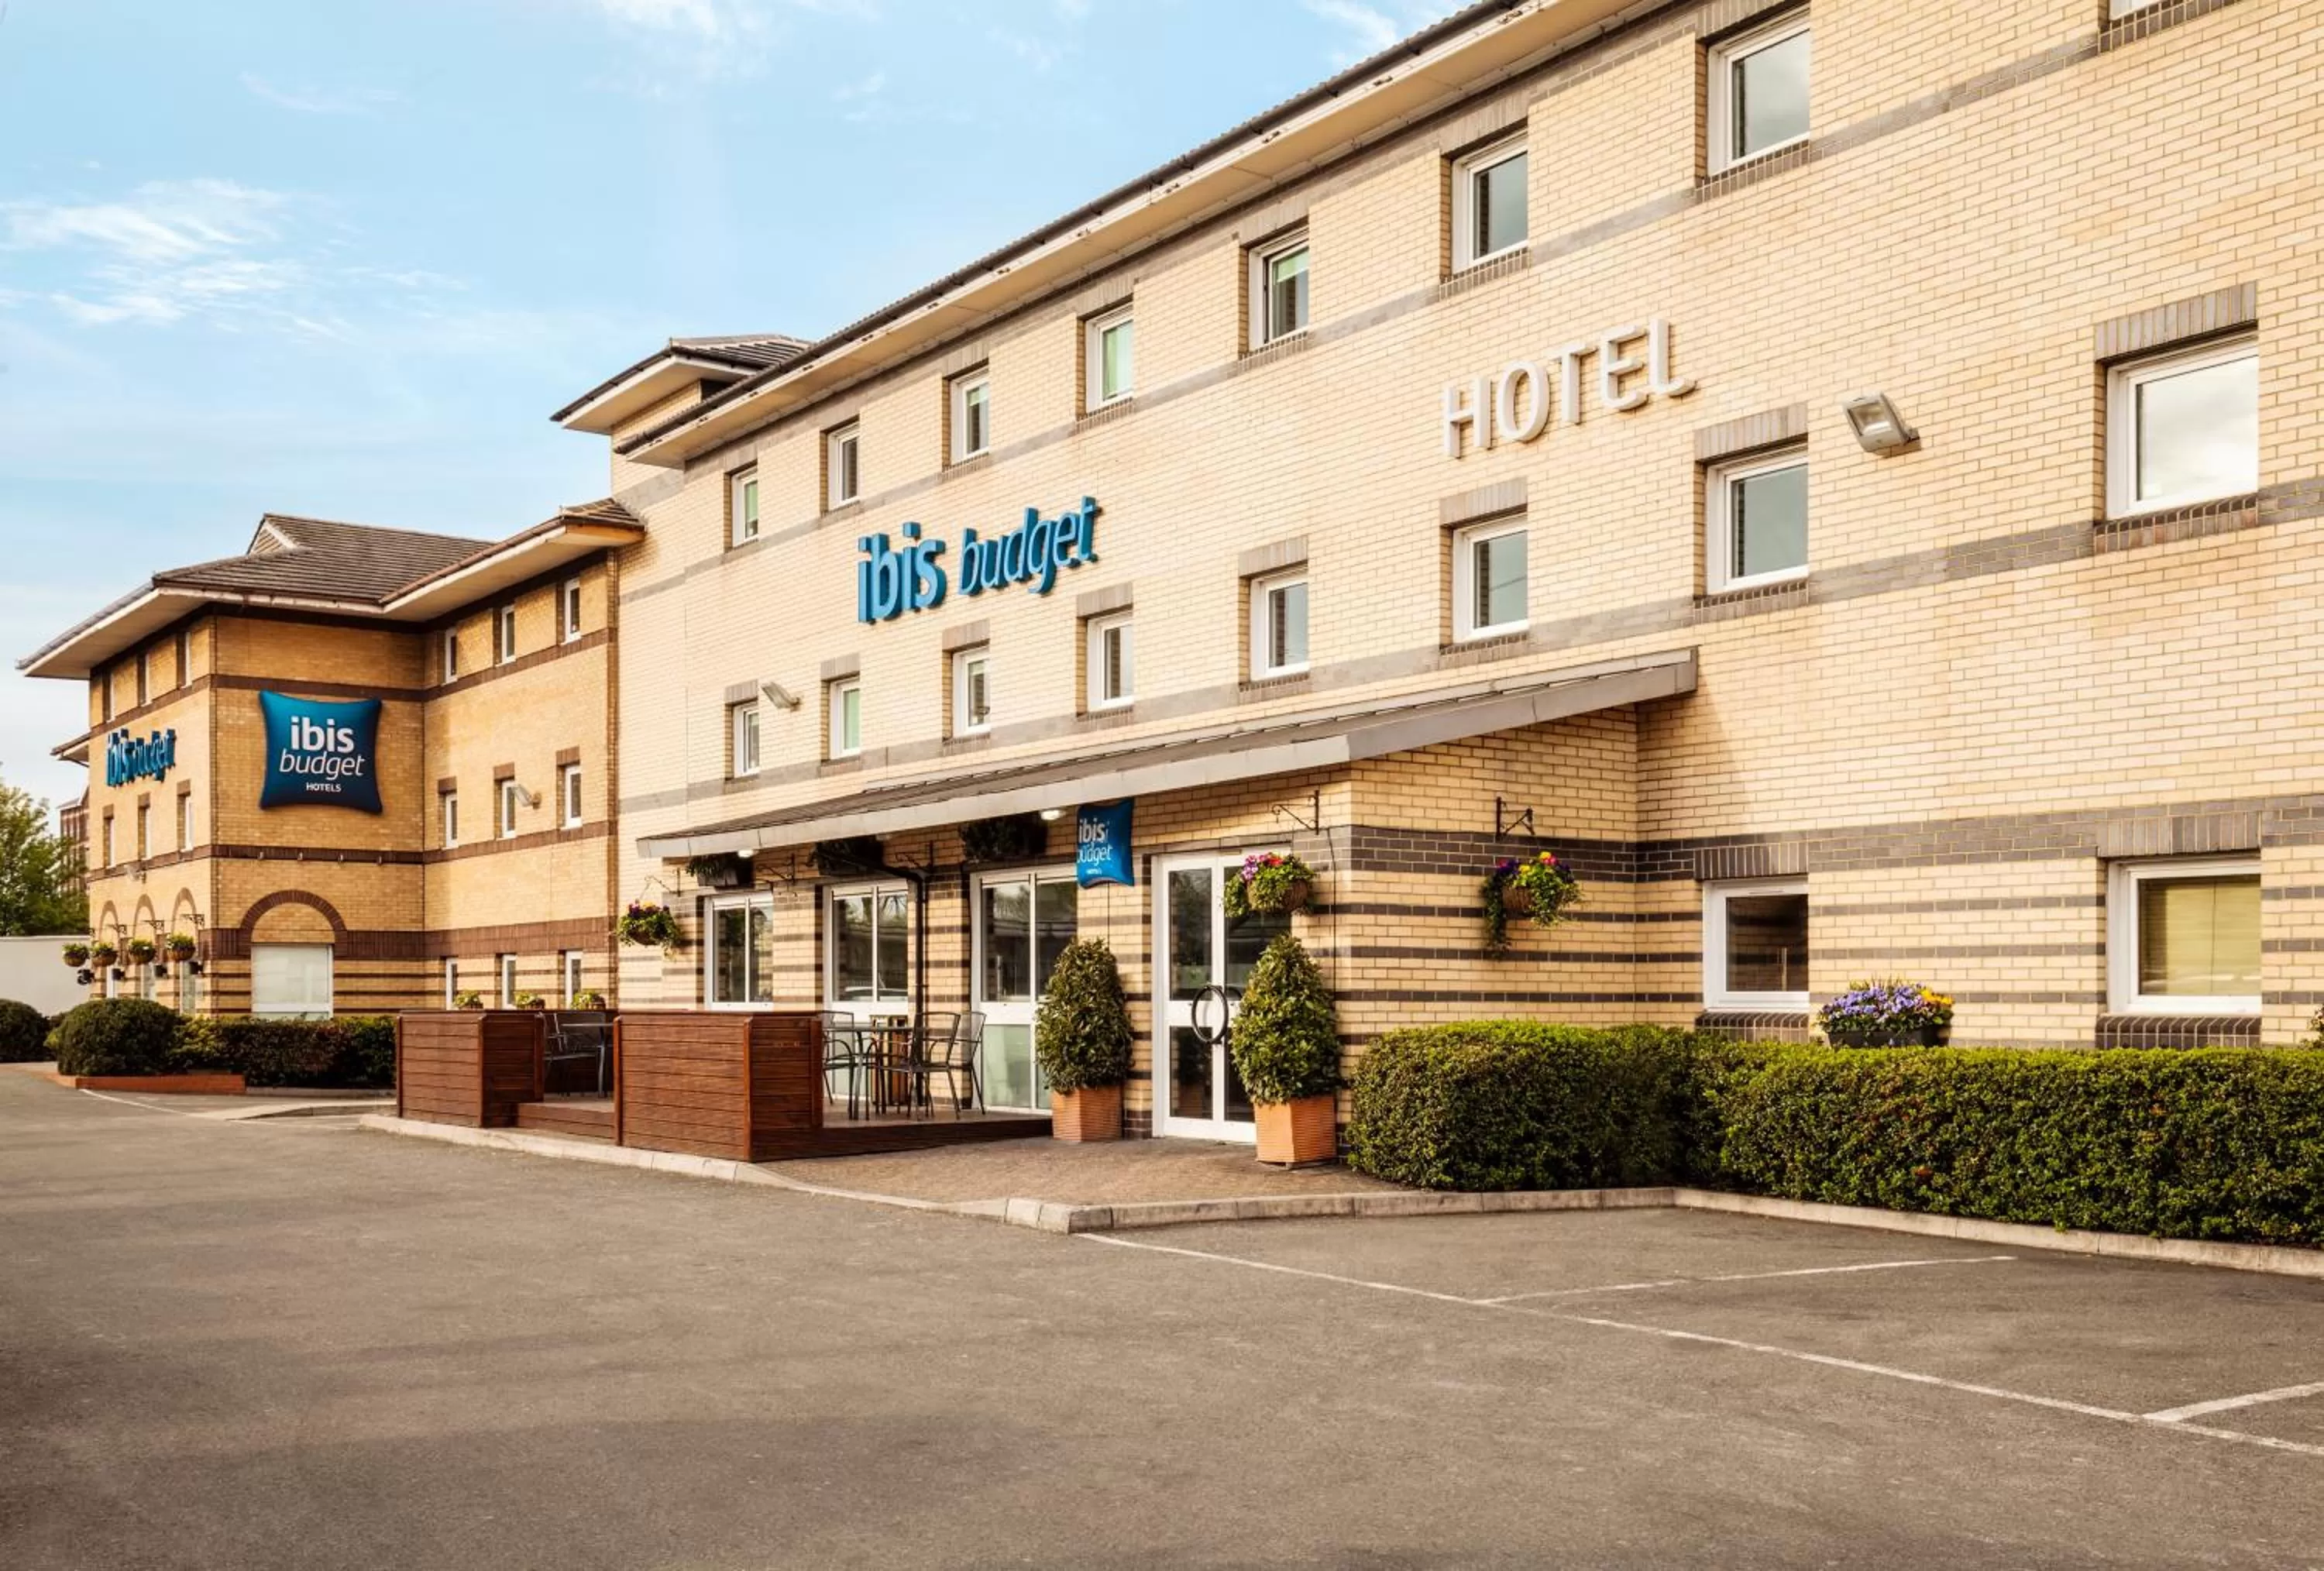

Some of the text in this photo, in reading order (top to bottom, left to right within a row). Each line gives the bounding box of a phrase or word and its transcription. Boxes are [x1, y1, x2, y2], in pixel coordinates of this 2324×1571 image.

[1442, 318, 1697, 458] HOTEL
[858, 496, 1098, 624] ibis budget
[290, 716, 355, 753] ibis
[279, 748, 366, 780] budget
[306, 782, 342, 792] HOTELS
[1079, 817, 1105, 843] ibis
